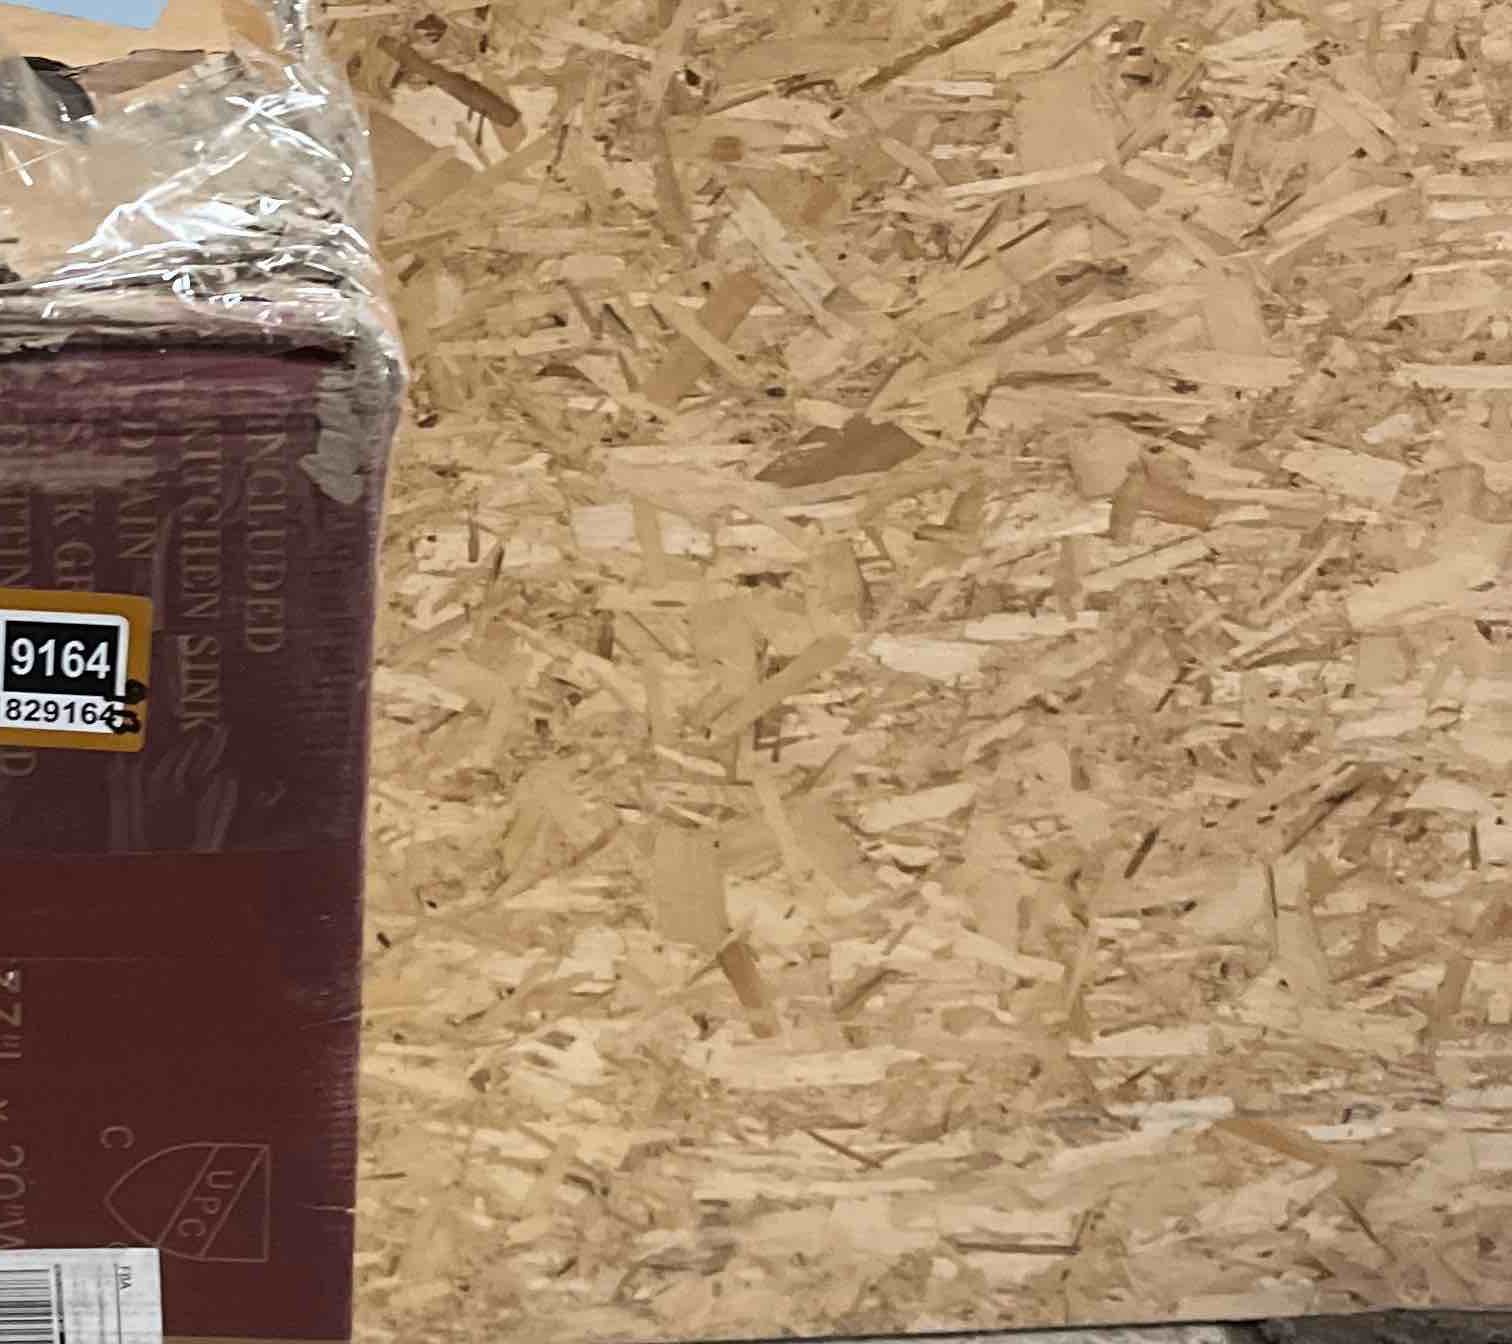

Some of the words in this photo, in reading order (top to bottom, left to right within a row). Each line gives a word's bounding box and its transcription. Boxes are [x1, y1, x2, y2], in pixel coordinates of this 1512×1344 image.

[118, 420, 159, 560] DAIN
[181, 418, 223, 620] KITCHEN
[245, 416, 287, 654] INCLUDED
[10, 637, 112, 681] 9164
[181, 634, 223, 731] SINK
[176, 1169, 234, 1238] UPC
